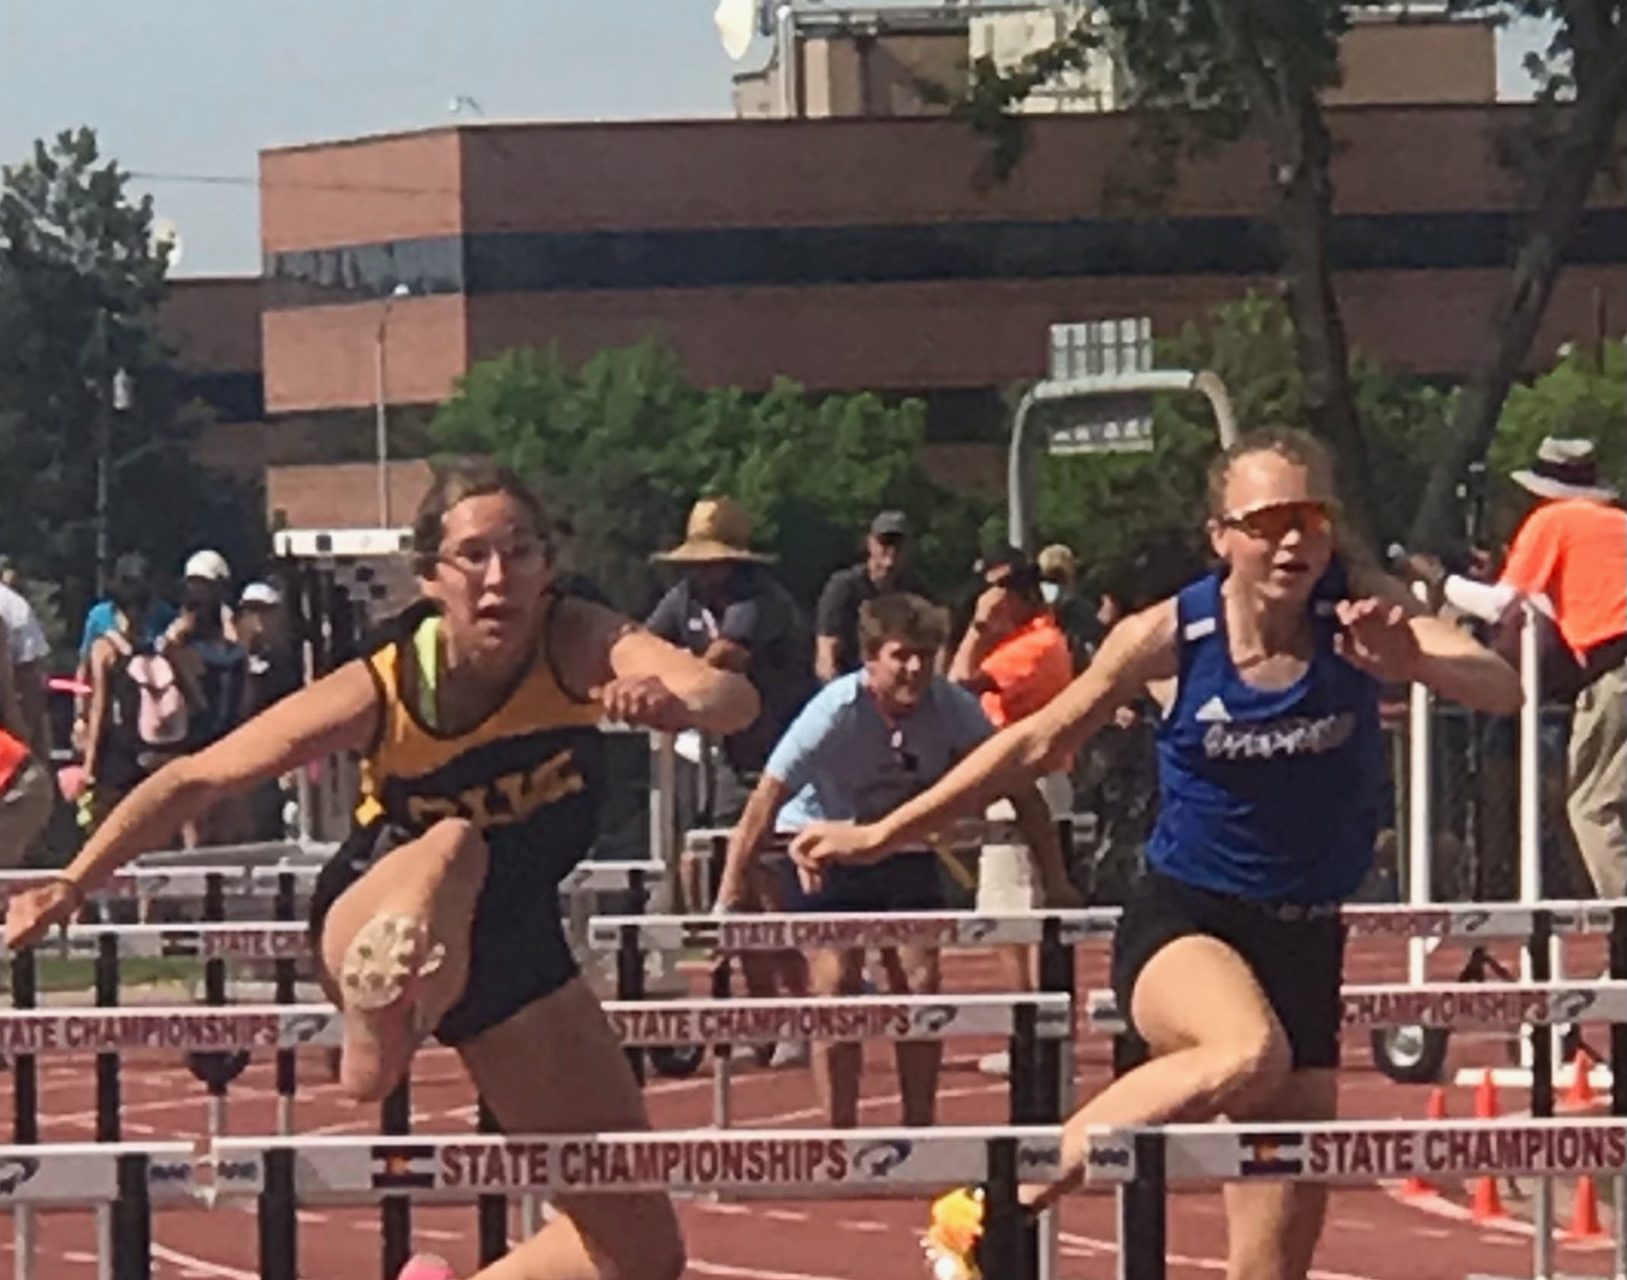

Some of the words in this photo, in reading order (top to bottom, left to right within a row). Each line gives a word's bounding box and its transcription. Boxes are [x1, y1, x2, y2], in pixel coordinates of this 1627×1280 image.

[611, 1011, 690, 1039] STATE
[700, 1003, 909, 1037] CHAMPIONSHIPS
[441, 1145, 548, 1185] STATE
[560, 1139, 847, 1184] CHAMPIONSHIPS
[1309, 1131, 1414, 1173] STATE
[1424, 1127, 1626, 1170] CHAMPIONS
